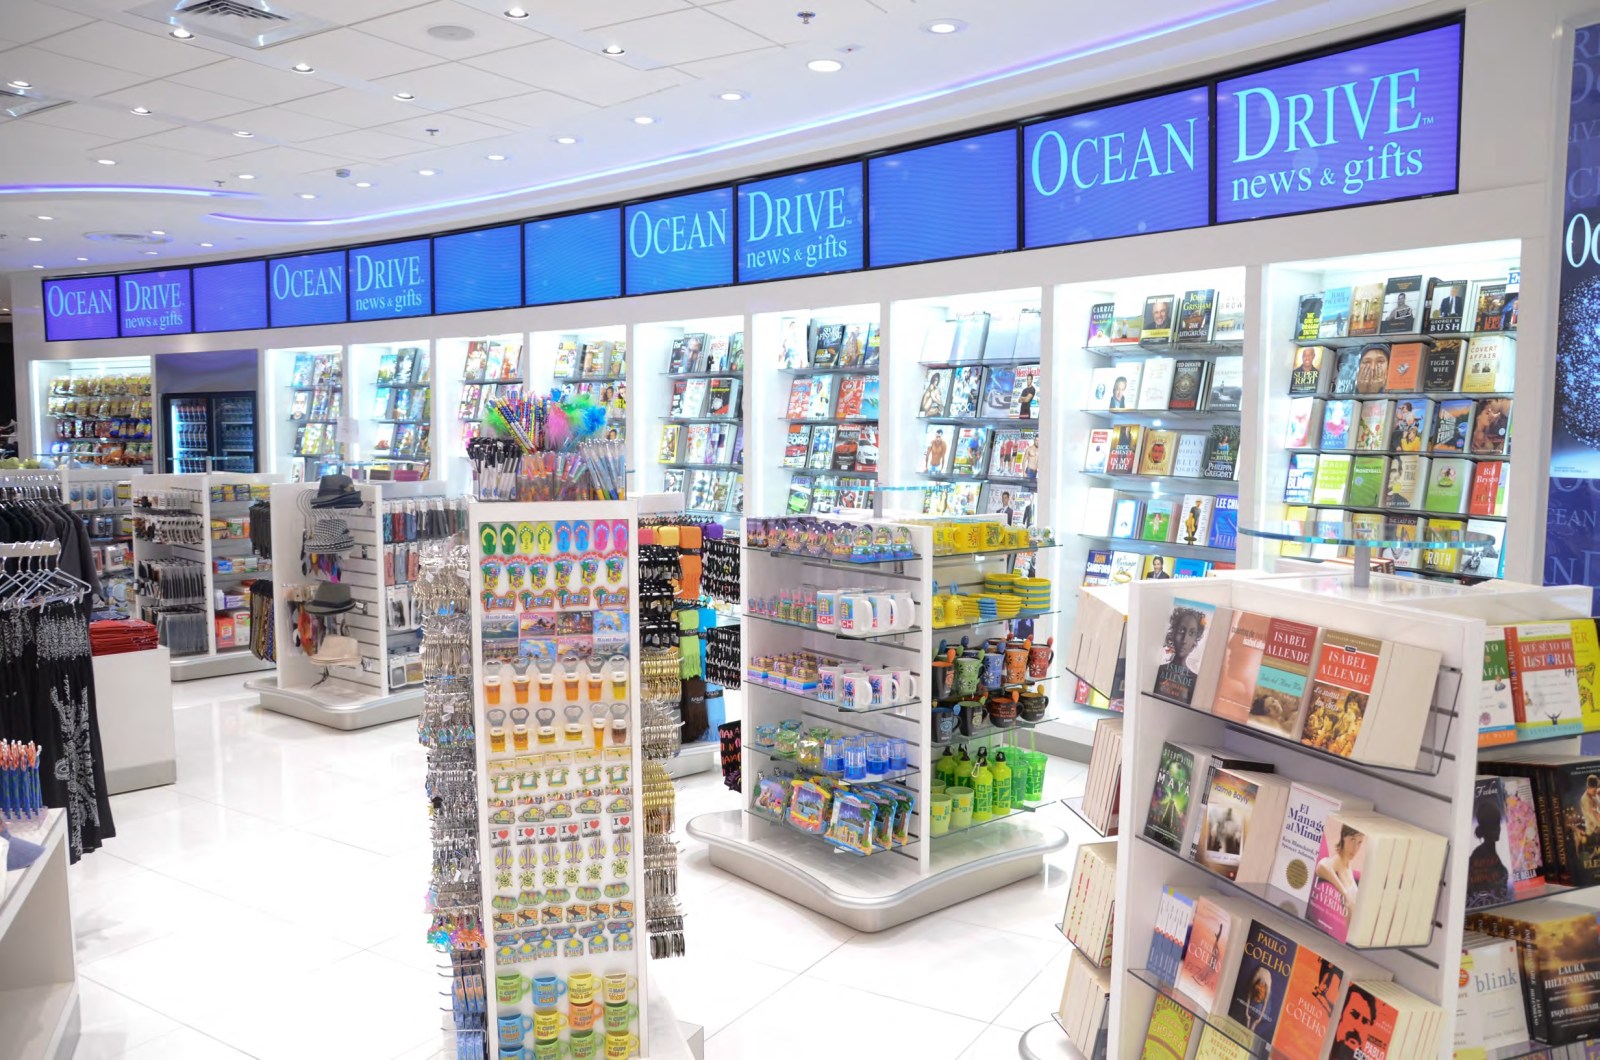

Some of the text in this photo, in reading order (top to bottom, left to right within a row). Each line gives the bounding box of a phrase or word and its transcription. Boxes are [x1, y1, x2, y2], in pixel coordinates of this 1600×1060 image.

[1232, 68, 1422, 163] DRIVE
[1031, 116, 1198, 197] OCEAN
[1231, 141, 1423, 202] news & gifts
[747, 186, 847, 242] DRIVE
[629, 208, 727, 258] OCEAN
[747, 234, 847, 268] news & gifts
[273, 264, 342, 300] OCEAN
[356, 255, 421, 292] DRIVE
[47, 285, 113, 317] OCEAN
[125, 280, 182, 312] DRIVE
[356, 288, 423, 312] news & gifts
[1182, 300, 1211, 311] GRISHAM
[125, 317, 151, 329] news
[159, 311, 183, 331] gifts
[1430, 324, 1460, 332] BUSH
[1470, 345, 1498, 353] COVERT
[1204, 470, 1233, 478] GREGORY
[1216, 498, 1226, 508] LEE
[1428, 551, 1452, 566] ROTH
[1273, 631, 1307, 648] ISABEL
[1484, 644, 1499, 654] YO
[1548, 642, 1560, 650] YO
[1561, 640, 1572, 648] DE
[1265, 644, 1310, 664] ALLENDE
[1328, 650, 1367, 670] ISABEL
[1522, 654, 1575, 668] HISTORIA
[1160, 671, 1193, 686] ALLENDE
[1166, 663, 1190, 676] ISABEL
[1320, 664, 1370, 686] ALLENDE
[1157, 772, 1190, 798] MAYA
[1214, 785, 1232, 796] Jaime
[1300, 803, 1310, 815] El
[1285, 822, 1294, 832] al
[1520, 869, 1536, 879] BELLA
[1258, 932, 1287, 956] PAULO
[1188, 943, 1222, 974] COELHO
[1244, 942, 1291, 977] COELHO
[1558, 963, 1586, 975] LAURA
[1475, 967, 1518, 992] blink
[1298, 997, 1322, 1018] PAULO
[1286, 1002, 1326, 1038] COELHO
[1152, 1021, 1184, 1050] CHOPRA
[1364, 1040, 1385, 1060] PABLO
